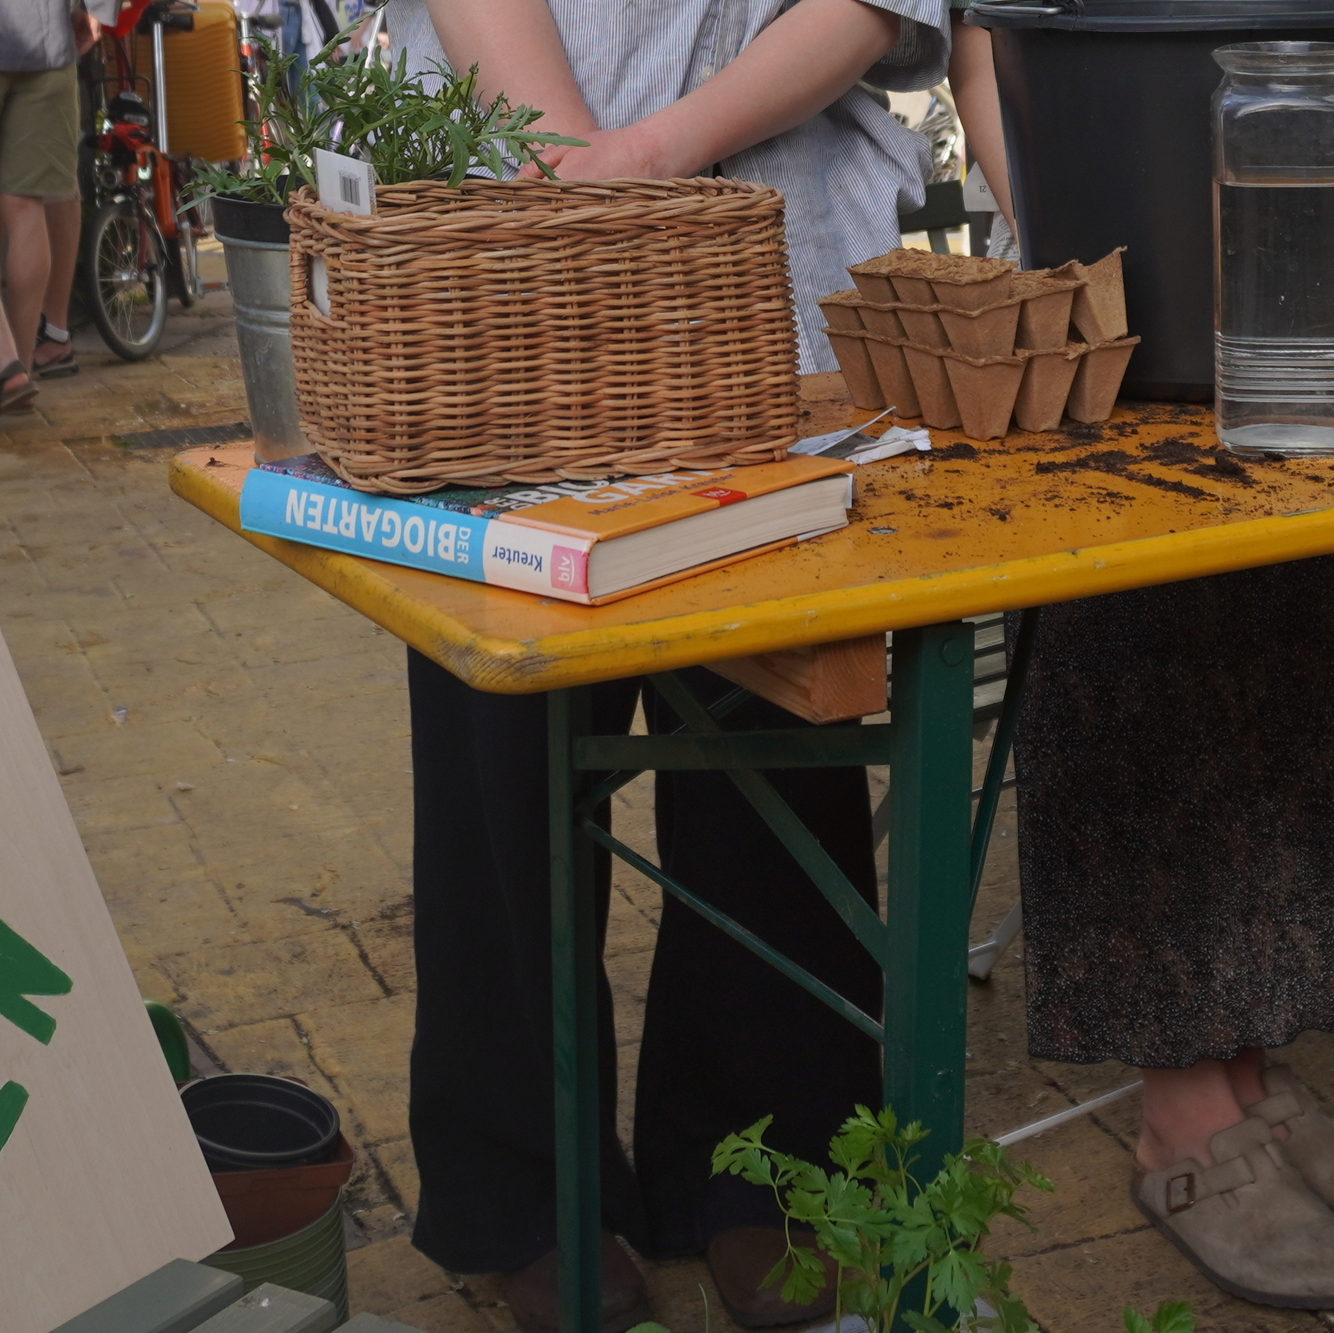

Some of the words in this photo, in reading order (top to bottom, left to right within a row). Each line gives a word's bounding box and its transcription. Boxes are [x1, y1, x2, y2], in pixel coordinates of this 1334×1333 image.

[285, 488, 458, 562] BIOGARTEN
[456, 527, 472, 564] DER
[492, 545, 543, 573] Kreuter
[556, 555, 571, 583] blv
